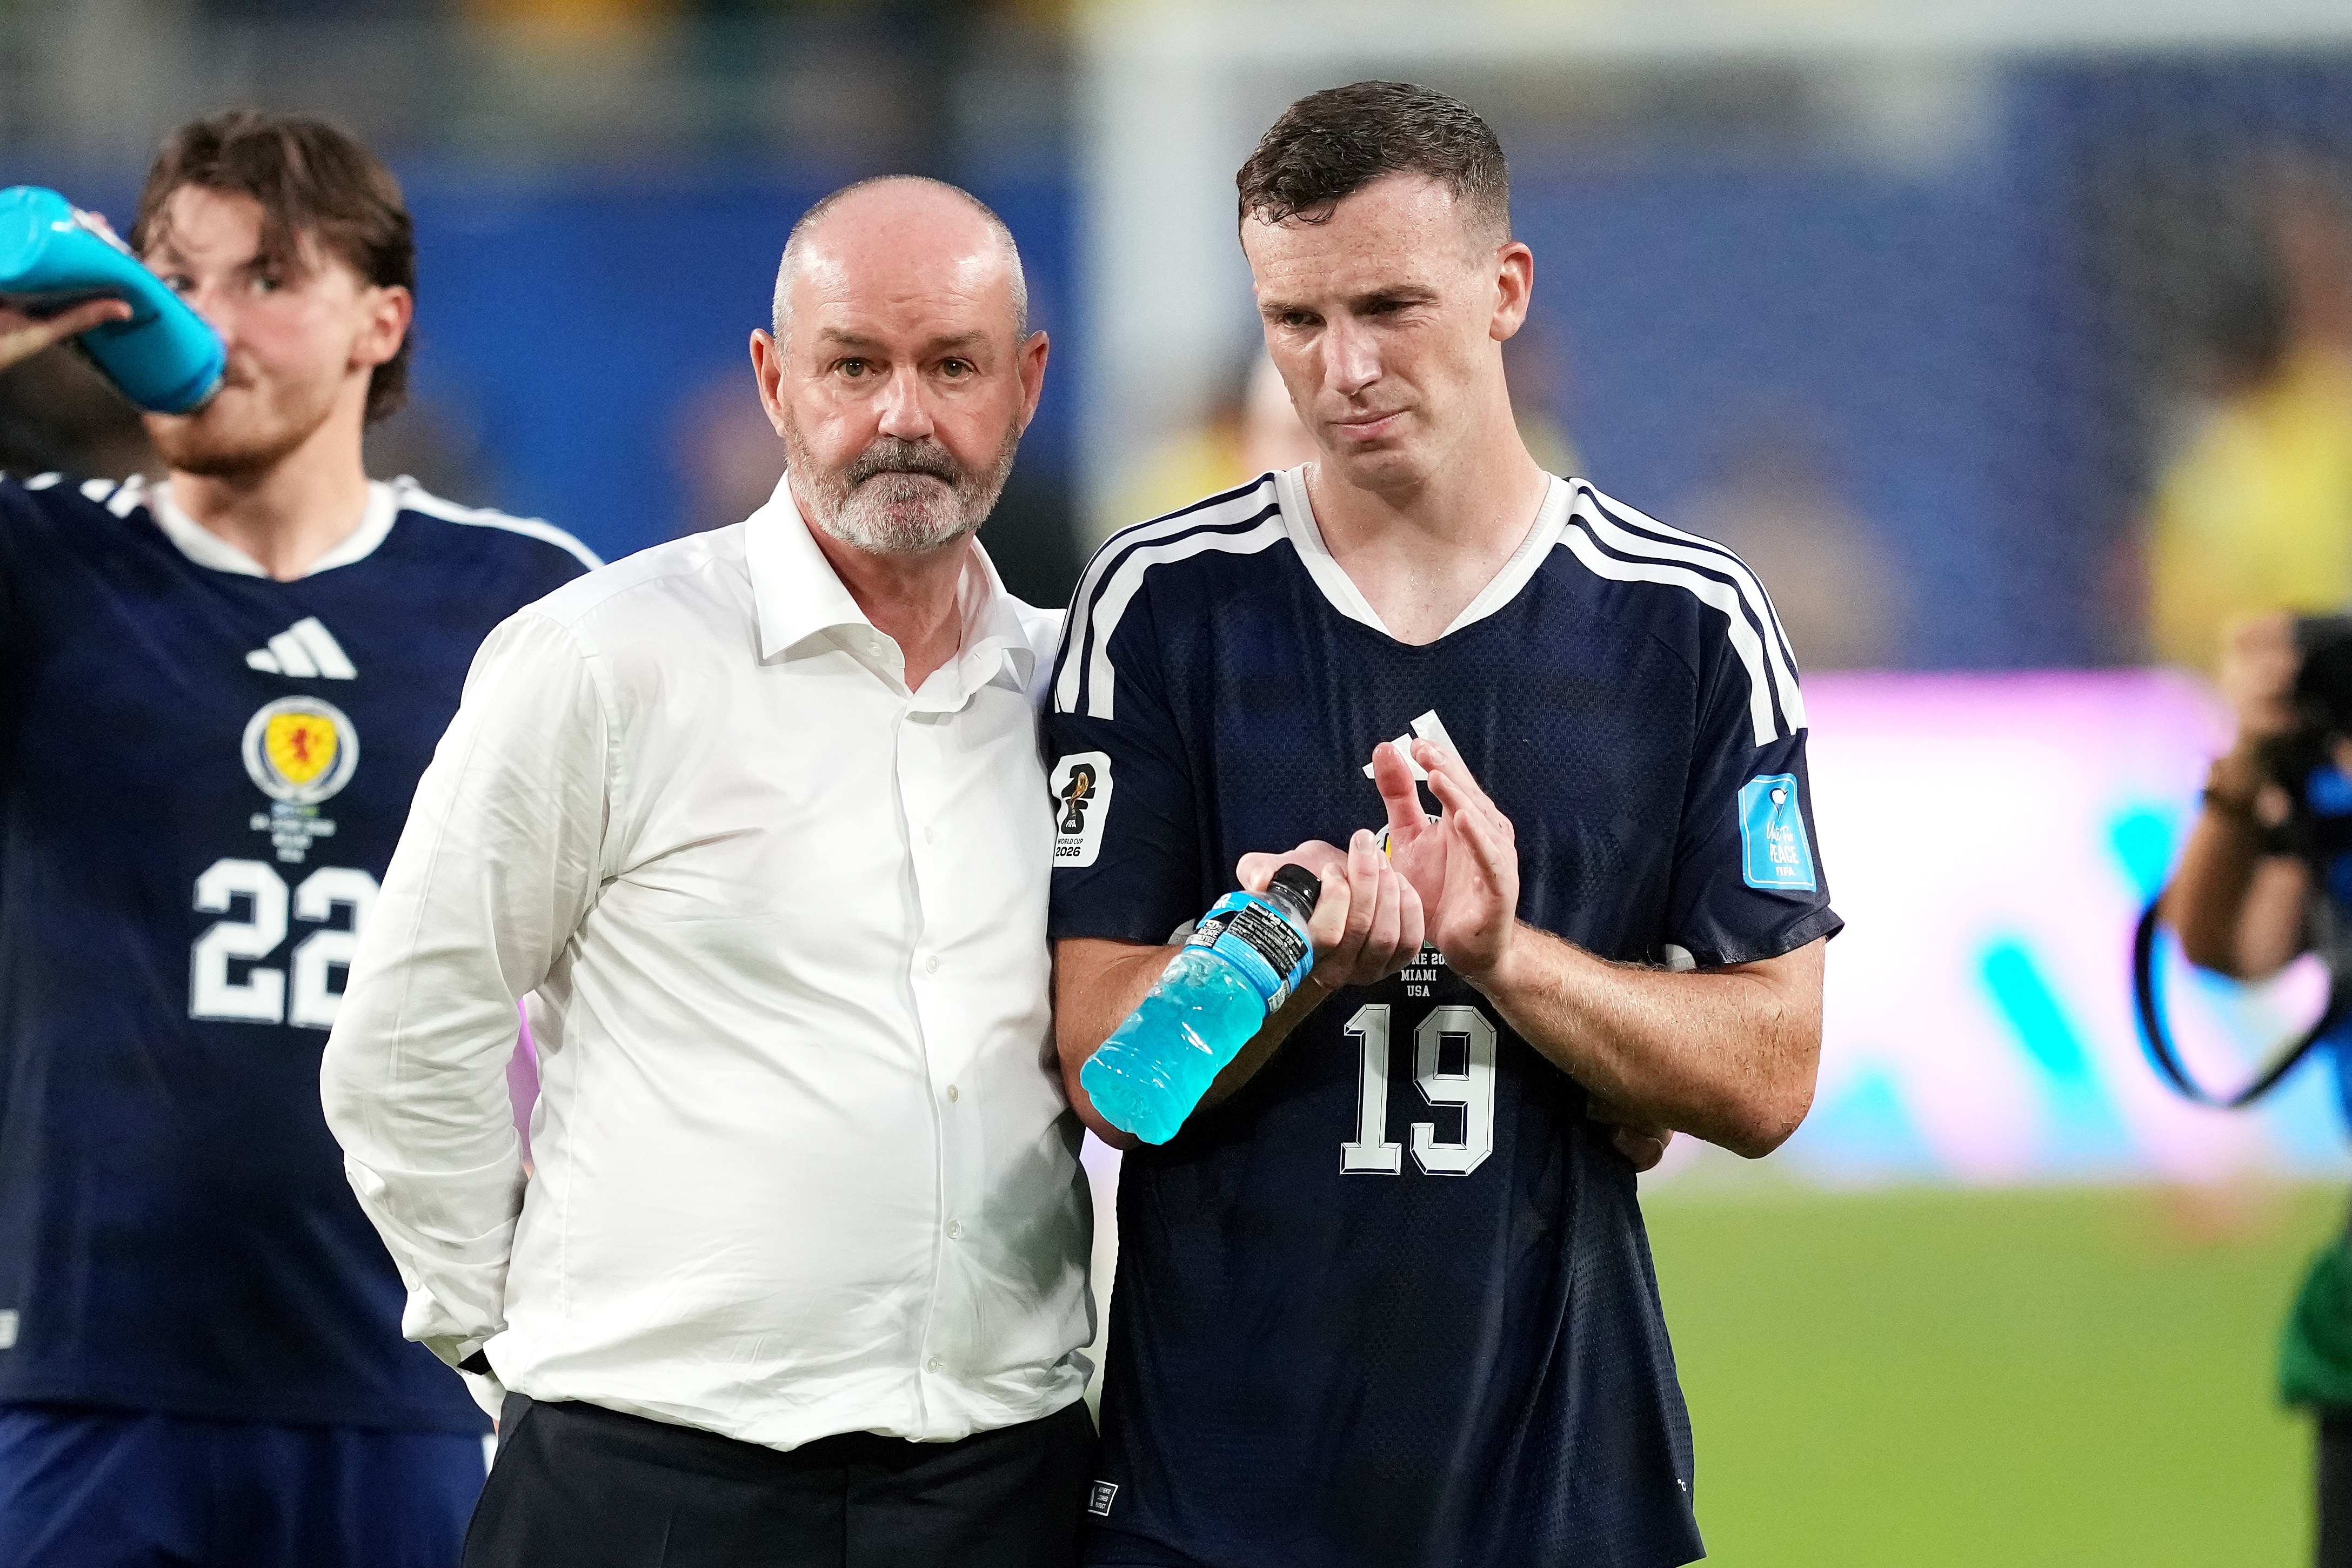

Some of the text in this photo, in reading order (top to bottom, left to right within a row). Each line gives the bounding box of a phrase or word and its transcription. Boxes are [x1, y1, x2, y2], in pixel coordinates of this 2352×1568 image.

[1055, 846, 1081, 856] 2026
[1769, 843, 1799, 864] PEACE
[1775, 866, 1795, 876] FIFA
[1198, 928, 1220, 938] MORE
[188, 857, 381, 1030] 22
[1412, 953, 1447, 965] NE 20
[1401, 969, 1436, 981] MIAMI
[1407, 985, 1430, 997] USA
[1340, 1004, 1496, 1176] 19
